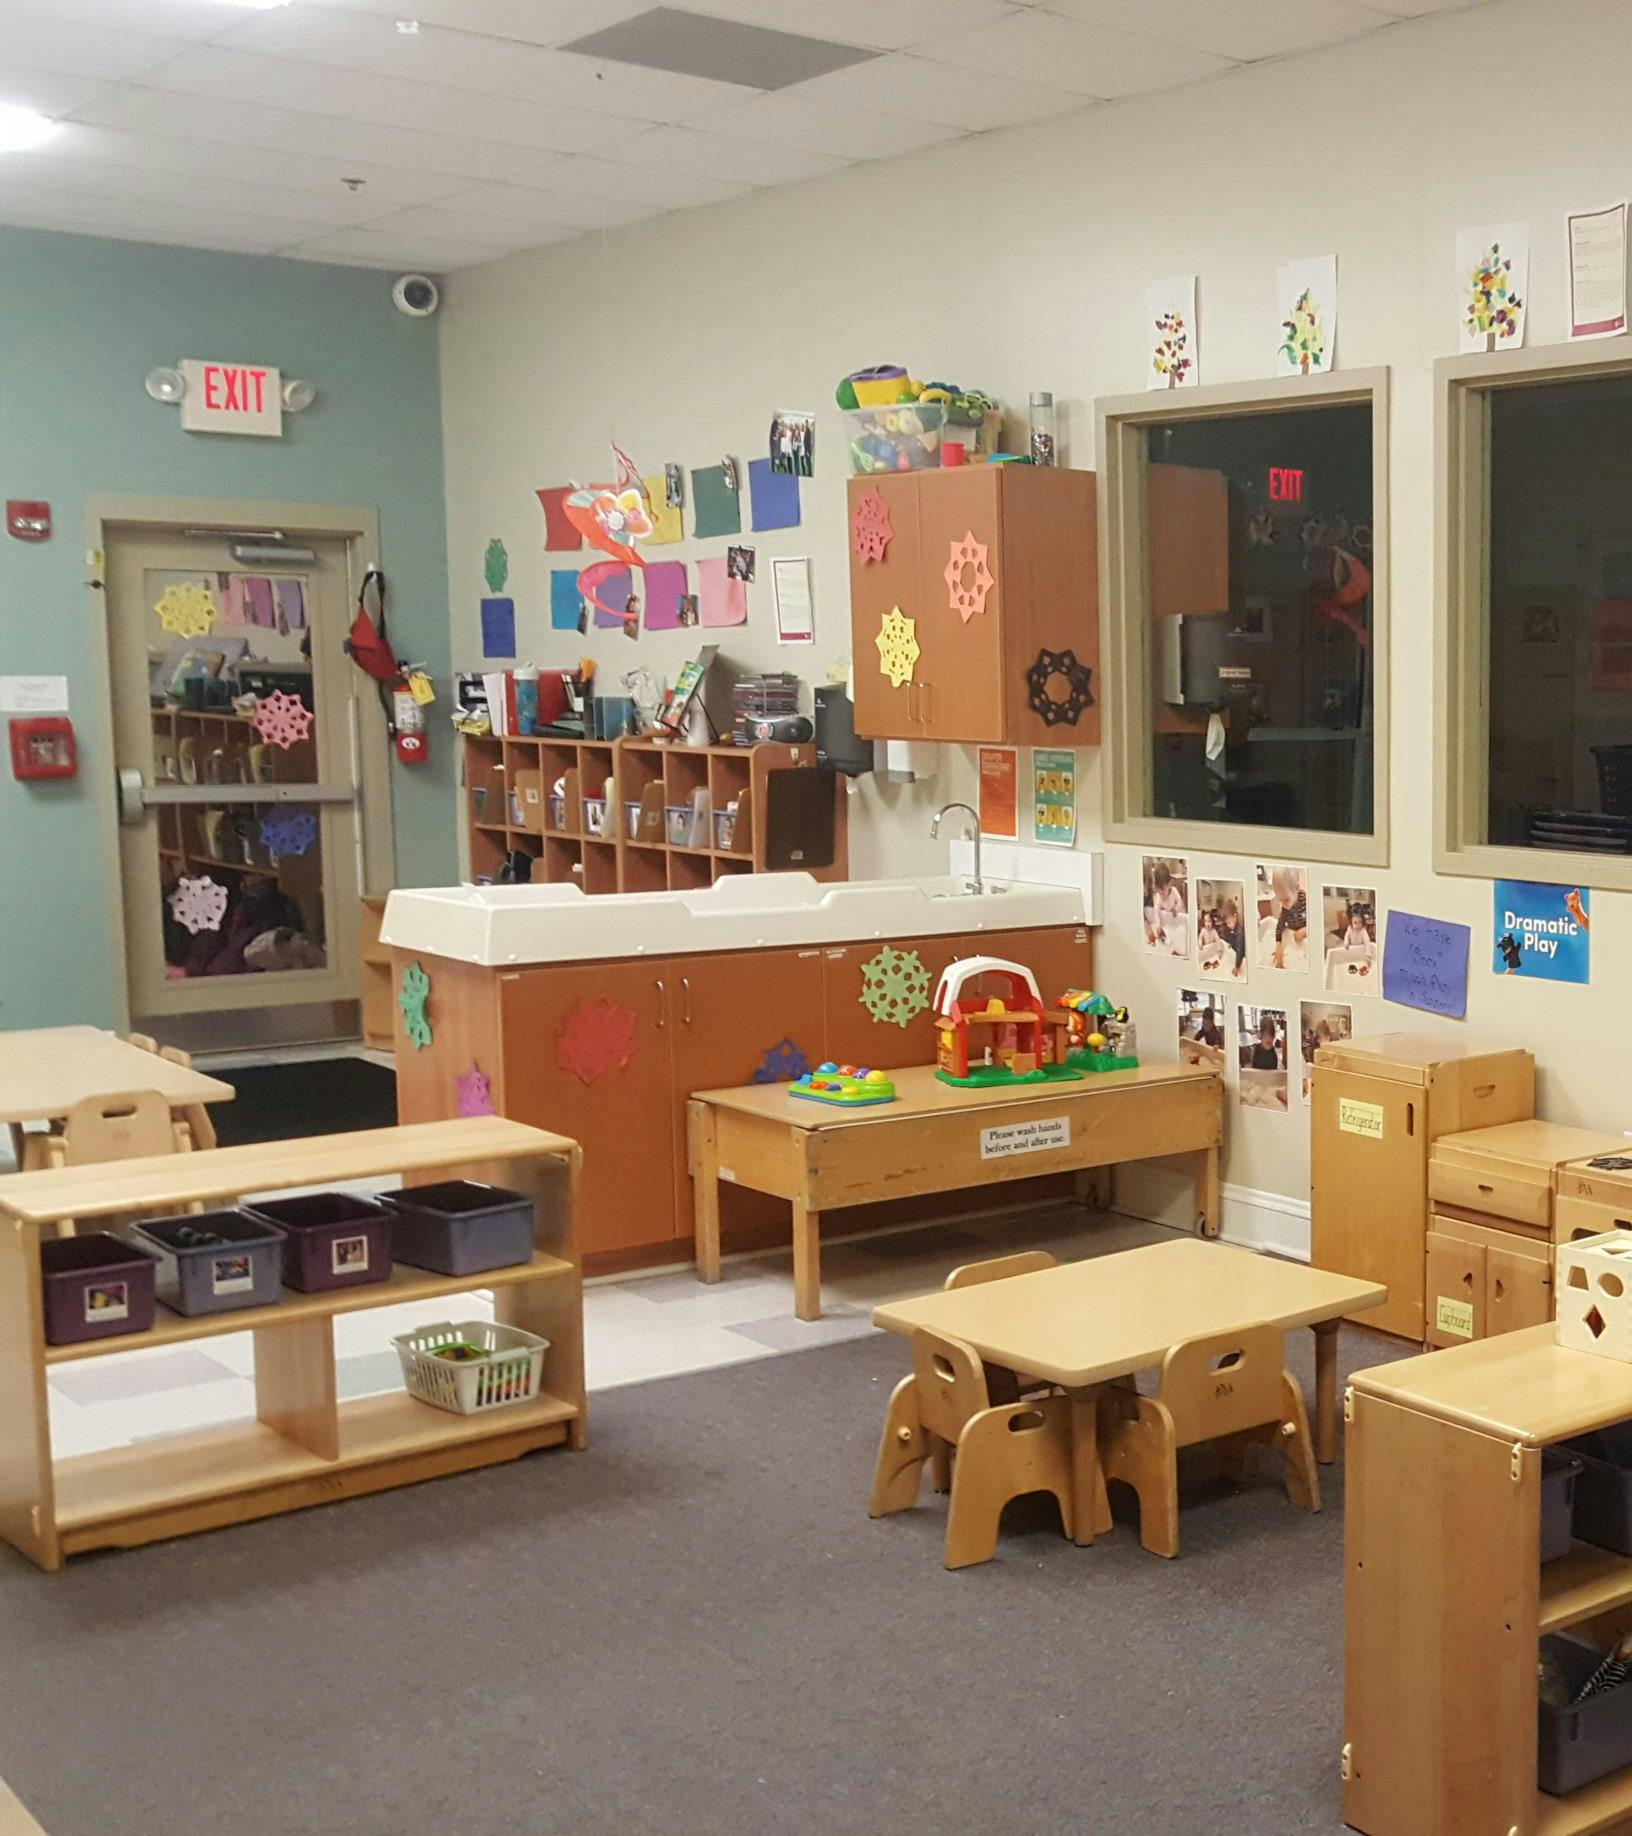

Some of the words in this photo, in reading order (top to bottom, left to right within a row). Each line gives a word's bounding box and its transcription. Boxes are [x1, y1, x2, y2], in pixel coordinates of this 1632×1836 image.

[204, 366, 267, 413] EXIT
[1269, 467, 1304, 502] EXIT
[1505, 911, 1578, 936] Dramatic
[1524, 932, 1558, 959] Play
[989, 1130, 1014, 1141] Please
[1017, 1125, 1037, 1136] wash
[1038, 1122, 1062, 1133] hands
[1342, 1105, 1381, 1132] Refrigerator
[985, 1142, 1011, 1154] before
[1013, 1139, 1029, 1149] and
[1031, 1137, 1048, 1147] after
[1050, 1136, 1066, 1144] use.
[1440, 1304, 1471, 1330] Cupboard
